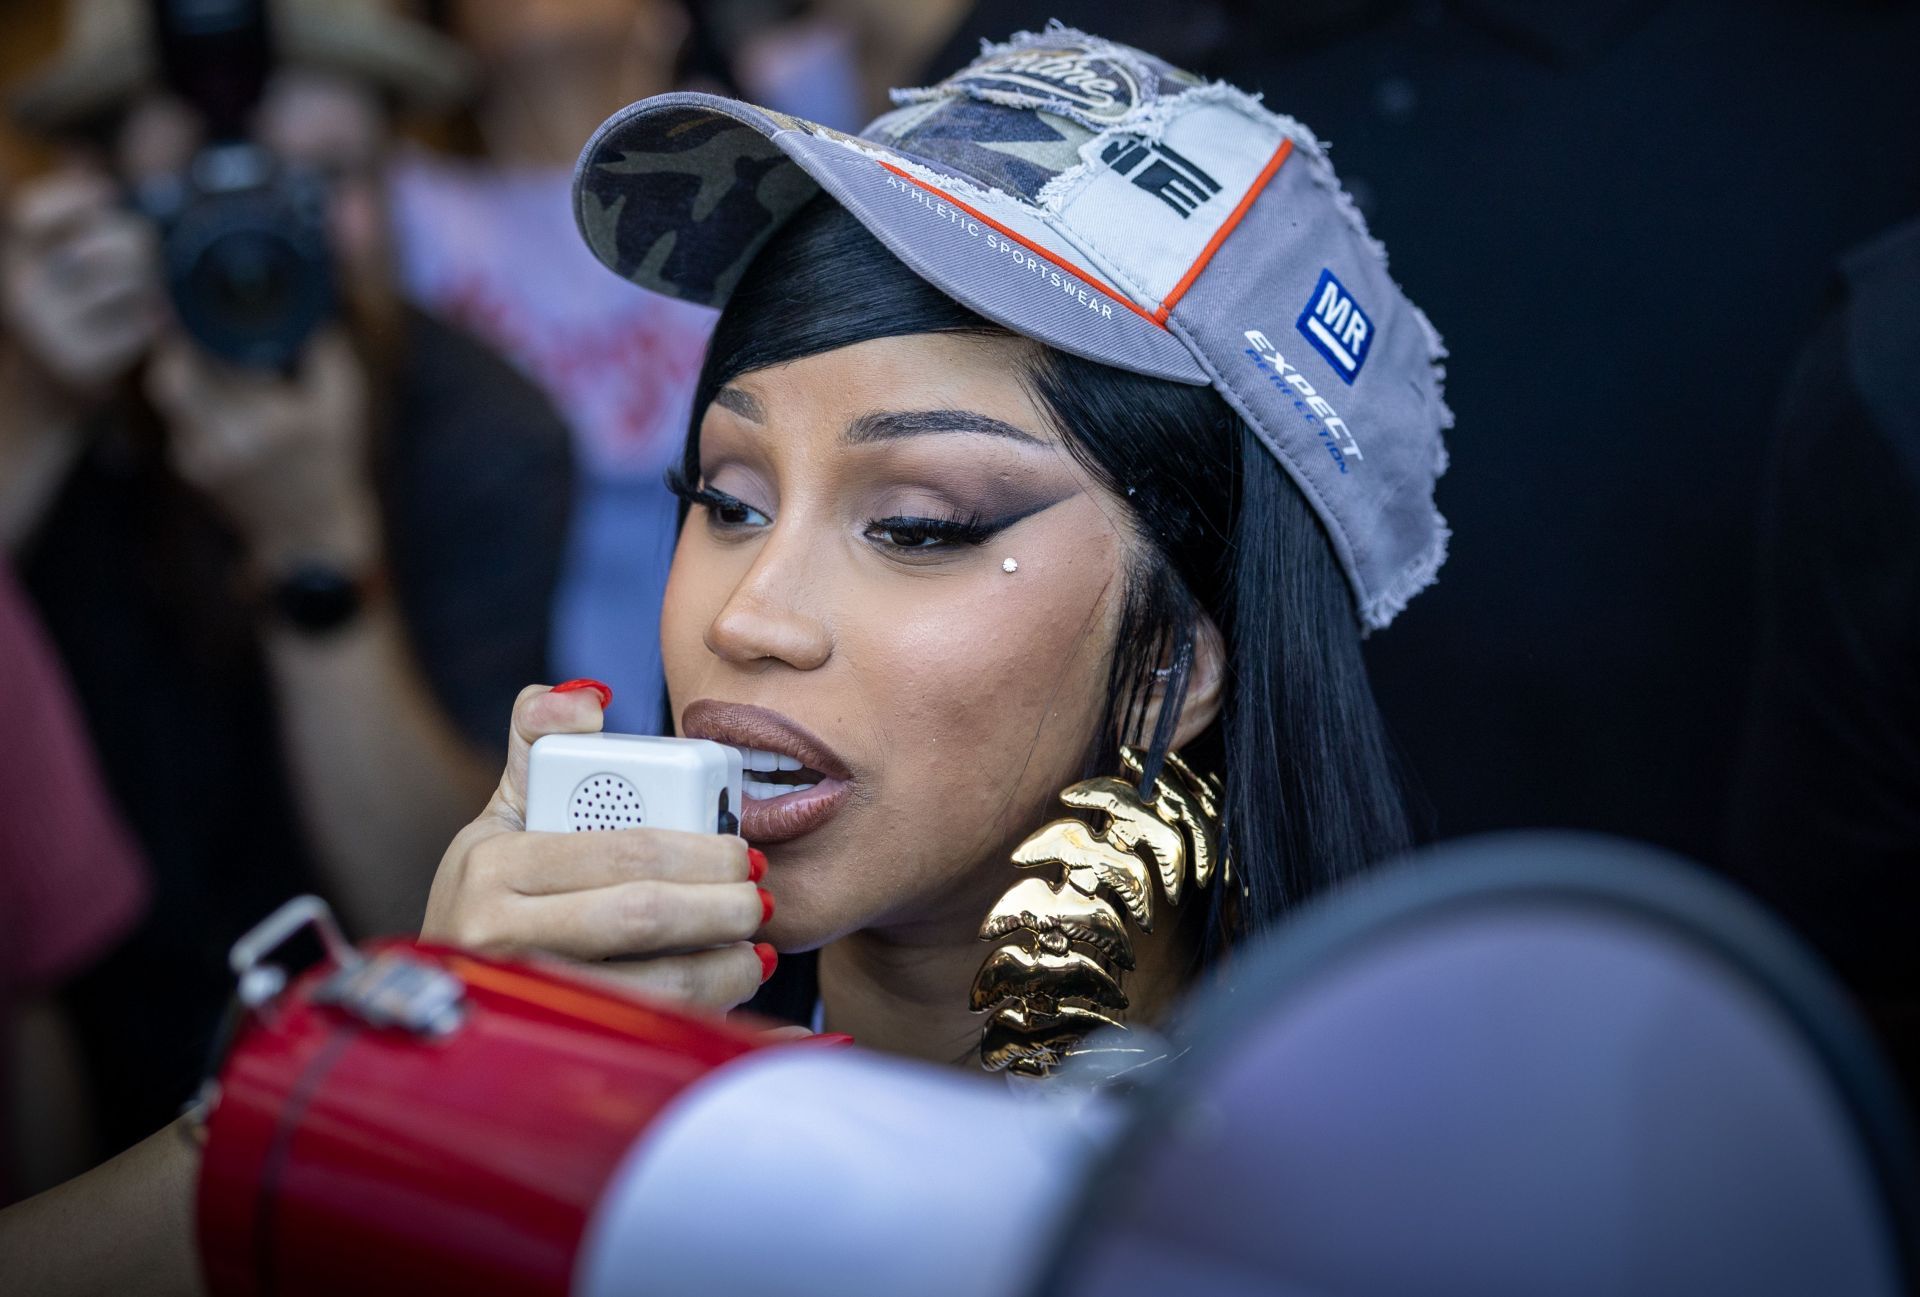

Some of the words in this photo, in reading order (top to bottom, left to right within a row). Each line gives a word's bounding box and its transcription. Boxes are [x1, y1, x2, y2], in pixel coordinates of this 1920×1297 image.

[886, 175, 979, 237] ATHLETIC
[986, 234, 1113, 320] SPORTSWEAR
[1315, 280, 1368, 356] MR
[1244, 330, 1364, 461] EXPECT
[1245, 348, 1349, 475] PERFECTION
